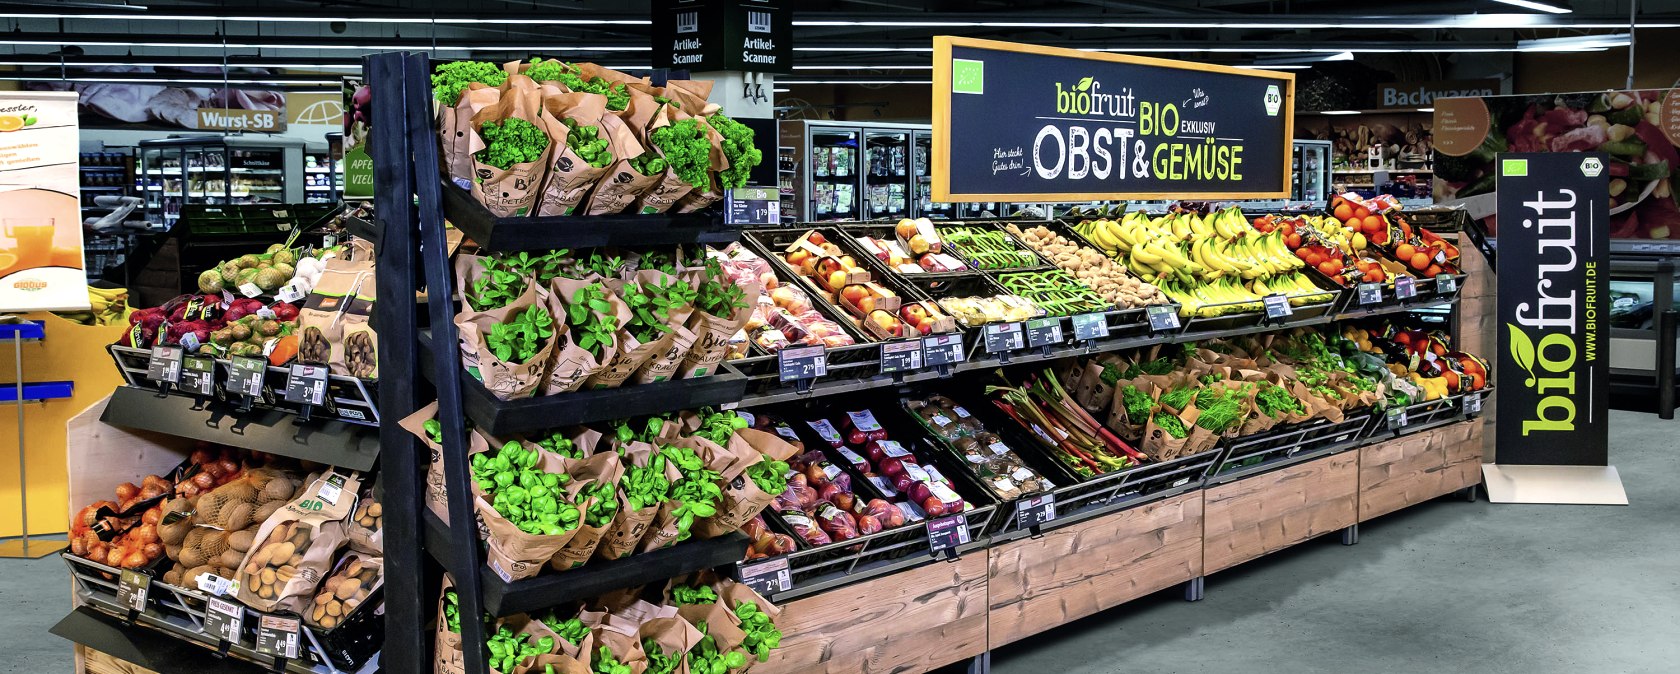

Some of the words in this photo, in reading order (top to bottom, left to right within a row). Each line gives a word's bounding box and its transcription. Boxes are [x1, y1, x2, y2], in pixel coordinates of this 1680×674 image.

[674, 38, 702, 50] Artikel-
[743, 37, 776, 50] Artikel-
[672, 54, 703, 64] Scanner
[743, 51, 776, 64] Scanner
[1056, 80, 1136, 118] biofruit
[1267, 94, 1279, 104] BIO
[201, 112, 275, 129] Wurst-SB
[1140, 101, 1180, 137] BIO
[1181, 120, 1216, 135] EXKLUSIV
[756, 189, 768, 199] Bio
[1515, 188, 1578, 437] biofruit
[1585, 261, 1597, 362] WWW.BIOFRUIT.DE
[701, 331, 727, 350] Bio
[299, 499, 324, 512] BIO
